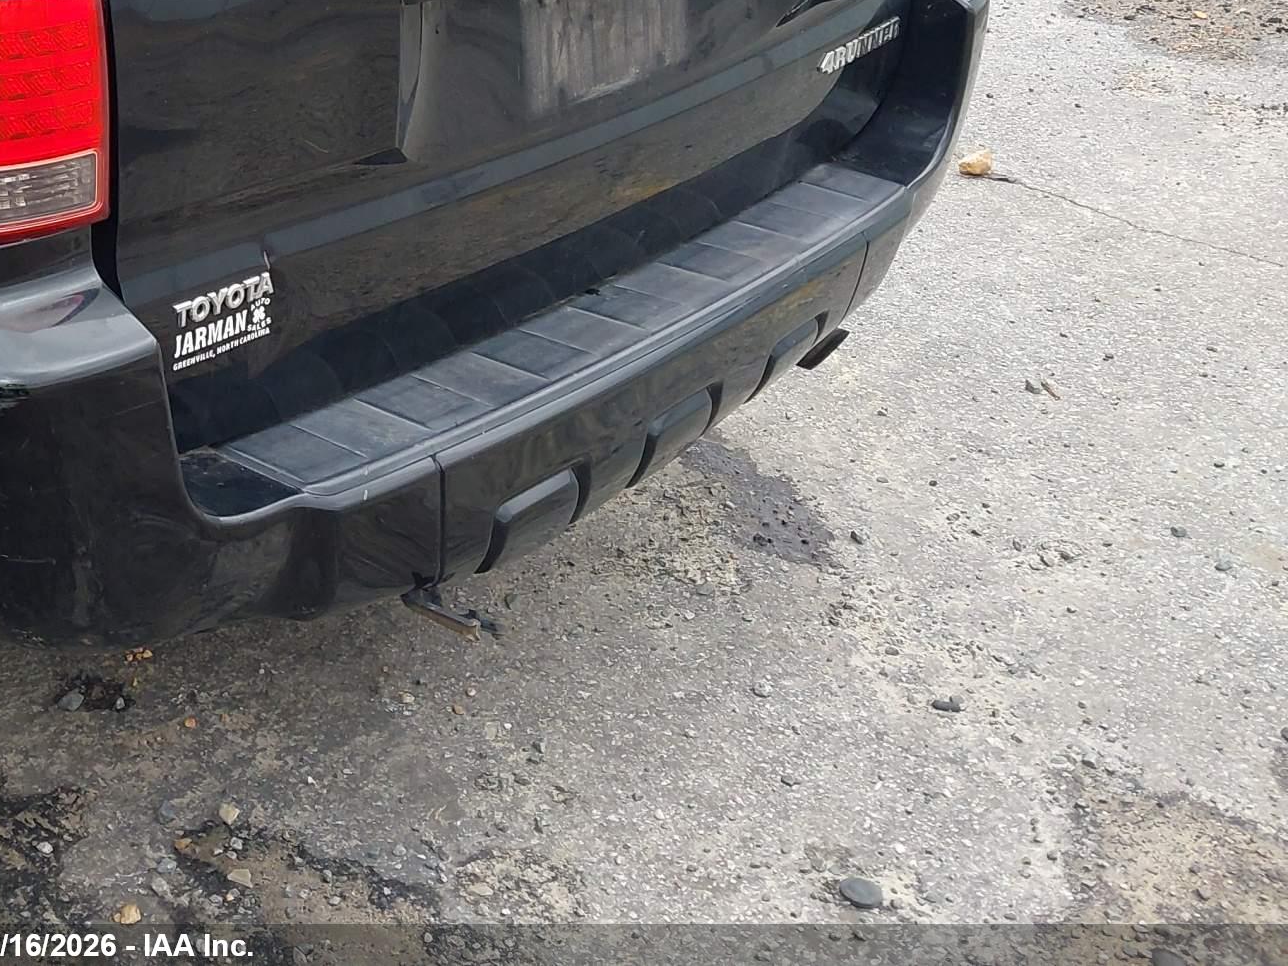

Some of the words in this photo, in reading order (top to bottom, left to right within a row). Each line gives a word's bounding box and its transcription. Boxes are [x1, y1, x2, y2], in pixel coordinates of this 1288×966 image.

[172, 271, 274, 328] TOYOTA
[250, 297, 271, 312] AUTO
[173, 309, 248, 359] JARMAN
[247, 316, 272, 332] SALES
[172, 349, 216, 371] GREENVILLE,
[216, 339, 239, 355] NORTH
[239, 326, 271, 345] CAROLINA
